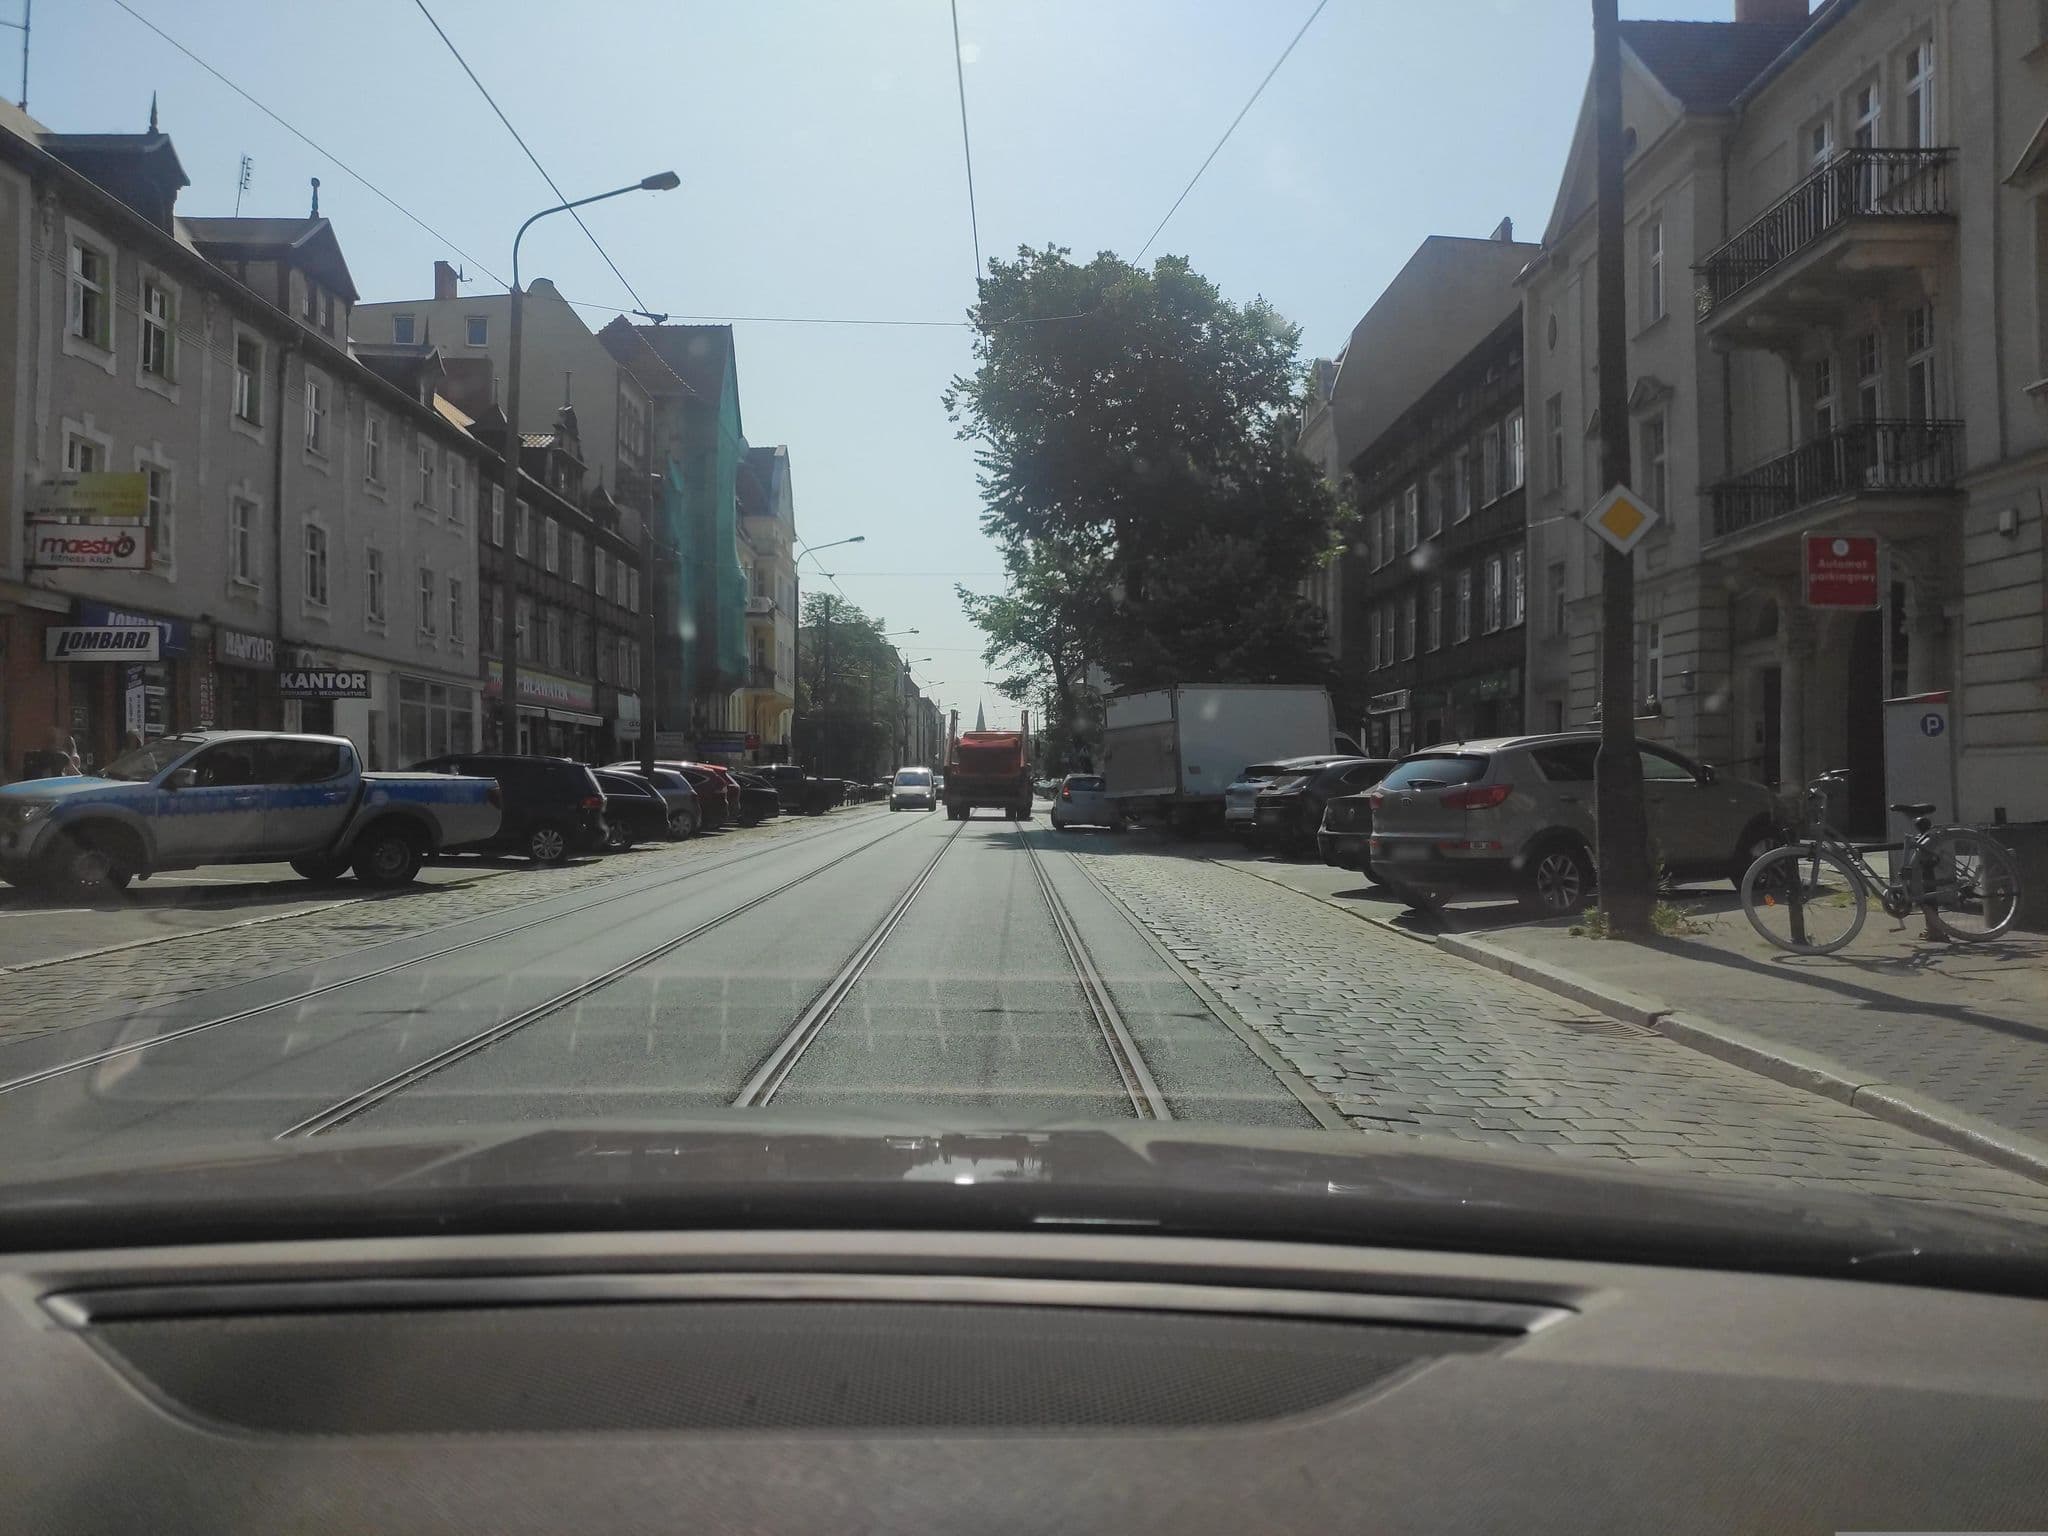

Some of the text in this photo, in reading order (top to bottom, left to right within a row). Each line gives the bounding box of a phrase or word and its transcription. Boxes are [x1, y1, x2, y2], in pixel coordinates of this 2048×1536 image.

[1817, 559, 1867, 569] Automat
[1810, 571, 1876, 584] parkingowy
[55, 631, 151, 657] LOMBARD
[225, 631, 273, 664] KANTOR
[280, 672, 367, 689] KANTOR
[1926, 716, 1940, 734] P
